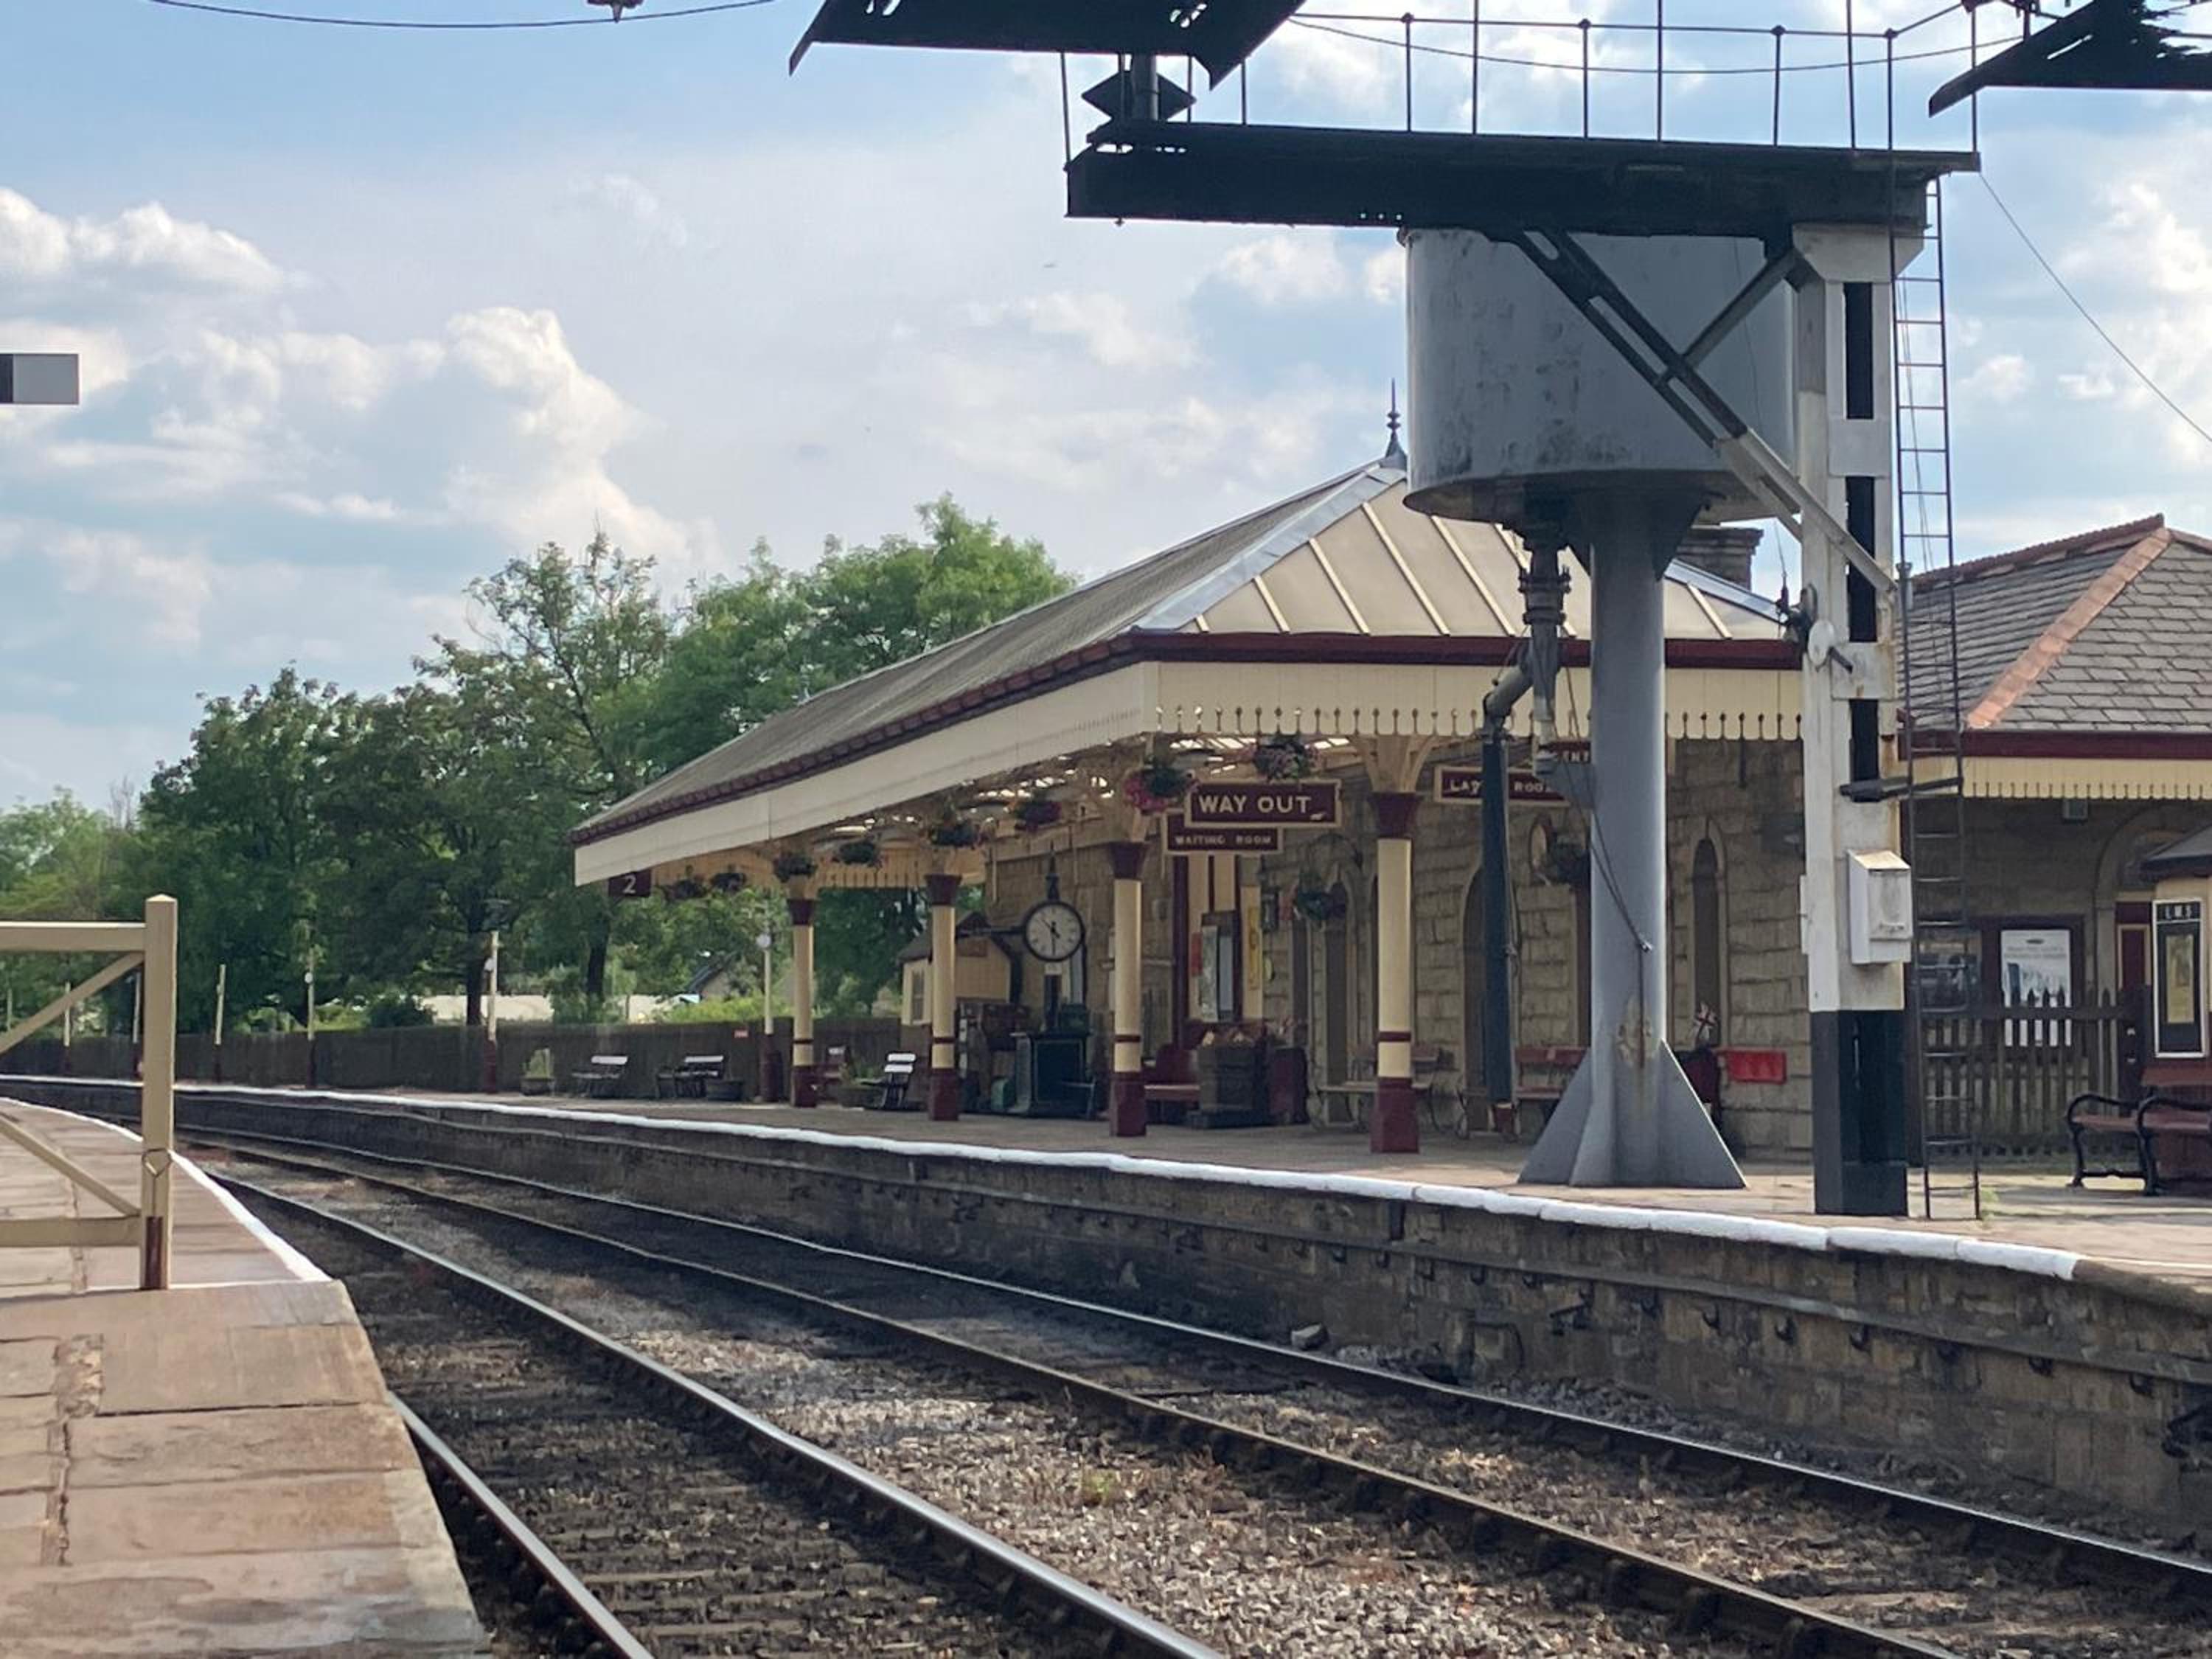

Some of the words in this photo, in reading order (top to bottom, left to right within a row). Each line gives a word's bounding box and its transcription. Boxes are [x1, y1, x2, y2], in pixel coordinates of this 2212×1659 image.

[1199, 796, 1247, 813] WAY
[1258, 796, 1312, 813] OUT
[1175, 835, 1225, 845] WAITING
[1236, 835, 1272, 845] ROOM
[623, 874, 636, 894] 2
